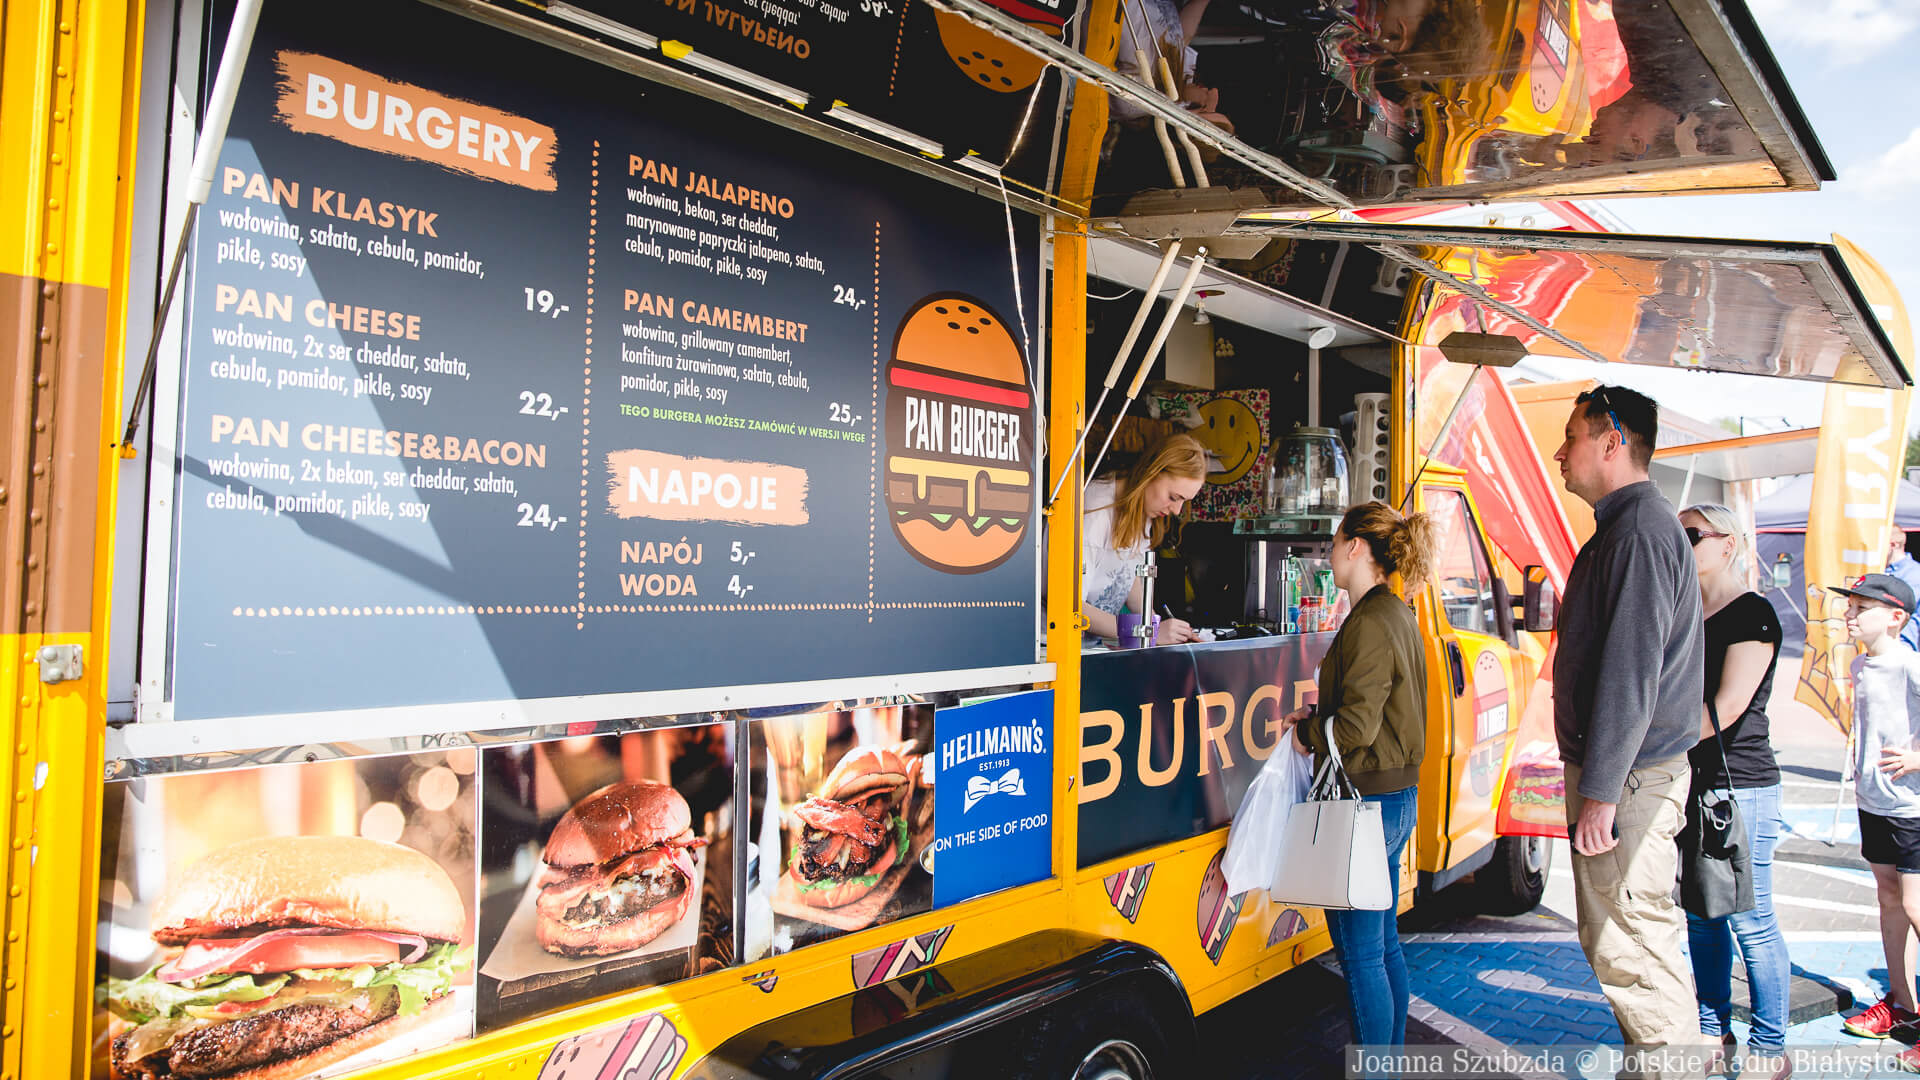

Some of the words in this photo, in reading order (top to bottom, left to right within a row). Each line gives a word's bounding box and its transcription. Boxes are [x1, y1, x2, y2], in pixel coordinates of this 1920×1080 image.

[305, 72, 542, 172] BURGERY
[223, 166, 299, 209] PAN
[312, 187, 439, 238] KLASYK
[629, 154, 678, 188] PAN
[684, 171, 795, 219] JALAPENO
[627, 185, 682, 217] wołowina,
[685, 197, 718, 226] bekon,
[721, 212, 737, 228] ser
[739, 215, 779, 241] cheddar,
[217, 237, 265, 271] pikle,
[271, 249, 306, 278] sosy
[219, 207, 305, 245] wołowina,
[310, 224, 361, 256] sałata,
[367, 236, 418, 267] cebula,
[424, 249, 485, 279] pomidor,
[625, 235, 665, 263] cebula,
[668, 246, 714, 272] pomidor,
[716, 257, 744, 280] pikle,
[746, 267, 767, 285] sosy
[626, 212, 697, 242] marynowane
[699, 230, 747, 254] papryczki
[748, 240, 793, 267] jalapeno,
[796, 251, 825, 275] sałata,
[215, 284, 292, 322] PAN
[305, 299, 421, 341] CHEESE
[524, 287, 569, 319] 19,-
[624, 289, 674, 319] PAN
[682, 301, 808, 343] CAMEMBERT
[833, 284, 866, 311] 24,-
[212, 324, 297, 359] wołowina,
[304, 335, 323, 358] 2x
[328, 340, 353, 362] ser
[356, 342, 419, 373] cheddar,
[424, 352, 471, 380] sałata,
[623, 319, 678, 348] wołowina,
[681, 329, 734, 358] grillowany
[737, 339, 793, 367] camembert,
[210, 355, 271, 387] cebula,
[278, 367, 348, 392] pomidor,
[353, 374, 395, 400] pikle,
[400, 381, 432, 405] sosy
[621, 373, 670, 396] pomidor,
[674, 381, 702, 402] pikle,
[706, 387, 728, 405] sosy
[622, 343, 673, 369] konfitura
[676, 354, 740, 382] żurawinowa,
[743, 366, 775, 388] sałata,
[777, 372, 810, 393] cebula,
[519, 391, 568, 421] 22,-
[620, 404, 650, 418] TEGO
[653, 408, 702, 424] BURGERA
[705, 413, 745, 429] MOŻESZ
[748, 419, 796, 435] ZAMÓWIĆ
[798, 426, 808, 436] W
[809, 427, 840, 440] WERSJI
[842, 431, 866, 443] WEGE
[829, 402, 862, 427] 25,-
[905, 396, 944, 453] PAN
[950, 404, 1020, 462] BURGER
[211, 415, 288, 448] PAN
[301, 423, 546, 468] CHEESE&BACON
[208, 453, 294, 485] wołowina,
[301, 459, 321, 482] 2x
[326, 460, 379, 488] bekon,
[383, 467, 406, 487] ser
[410, 466, 469, 495] cheddar,
[474, 471, 518, 497] sałata,
[628, 466, 777, 511] NAPOJE
[206, 485, 268, 516] cebula,
[274, 494, 346, 519] pomidor,
[352, 497, 394, 521] pikle,
[399, 503, 430, 523] sosy
[517, 503, 567, 531] 24,-
[620, 536, 703, 565] NAPÓJ
[730, 541, 756, 565] 5,-
[620, 573, 697, 597] WODA
[727, 574, 753, 598] 4,-
[935, 836, 952, 852] ON
[955, 831, 975, 847] THE
[979, 824, 1001, 841] SIDE
[1004, 820, 1017, 835] OF
[1020, 813, 1048, 831] FOOD
